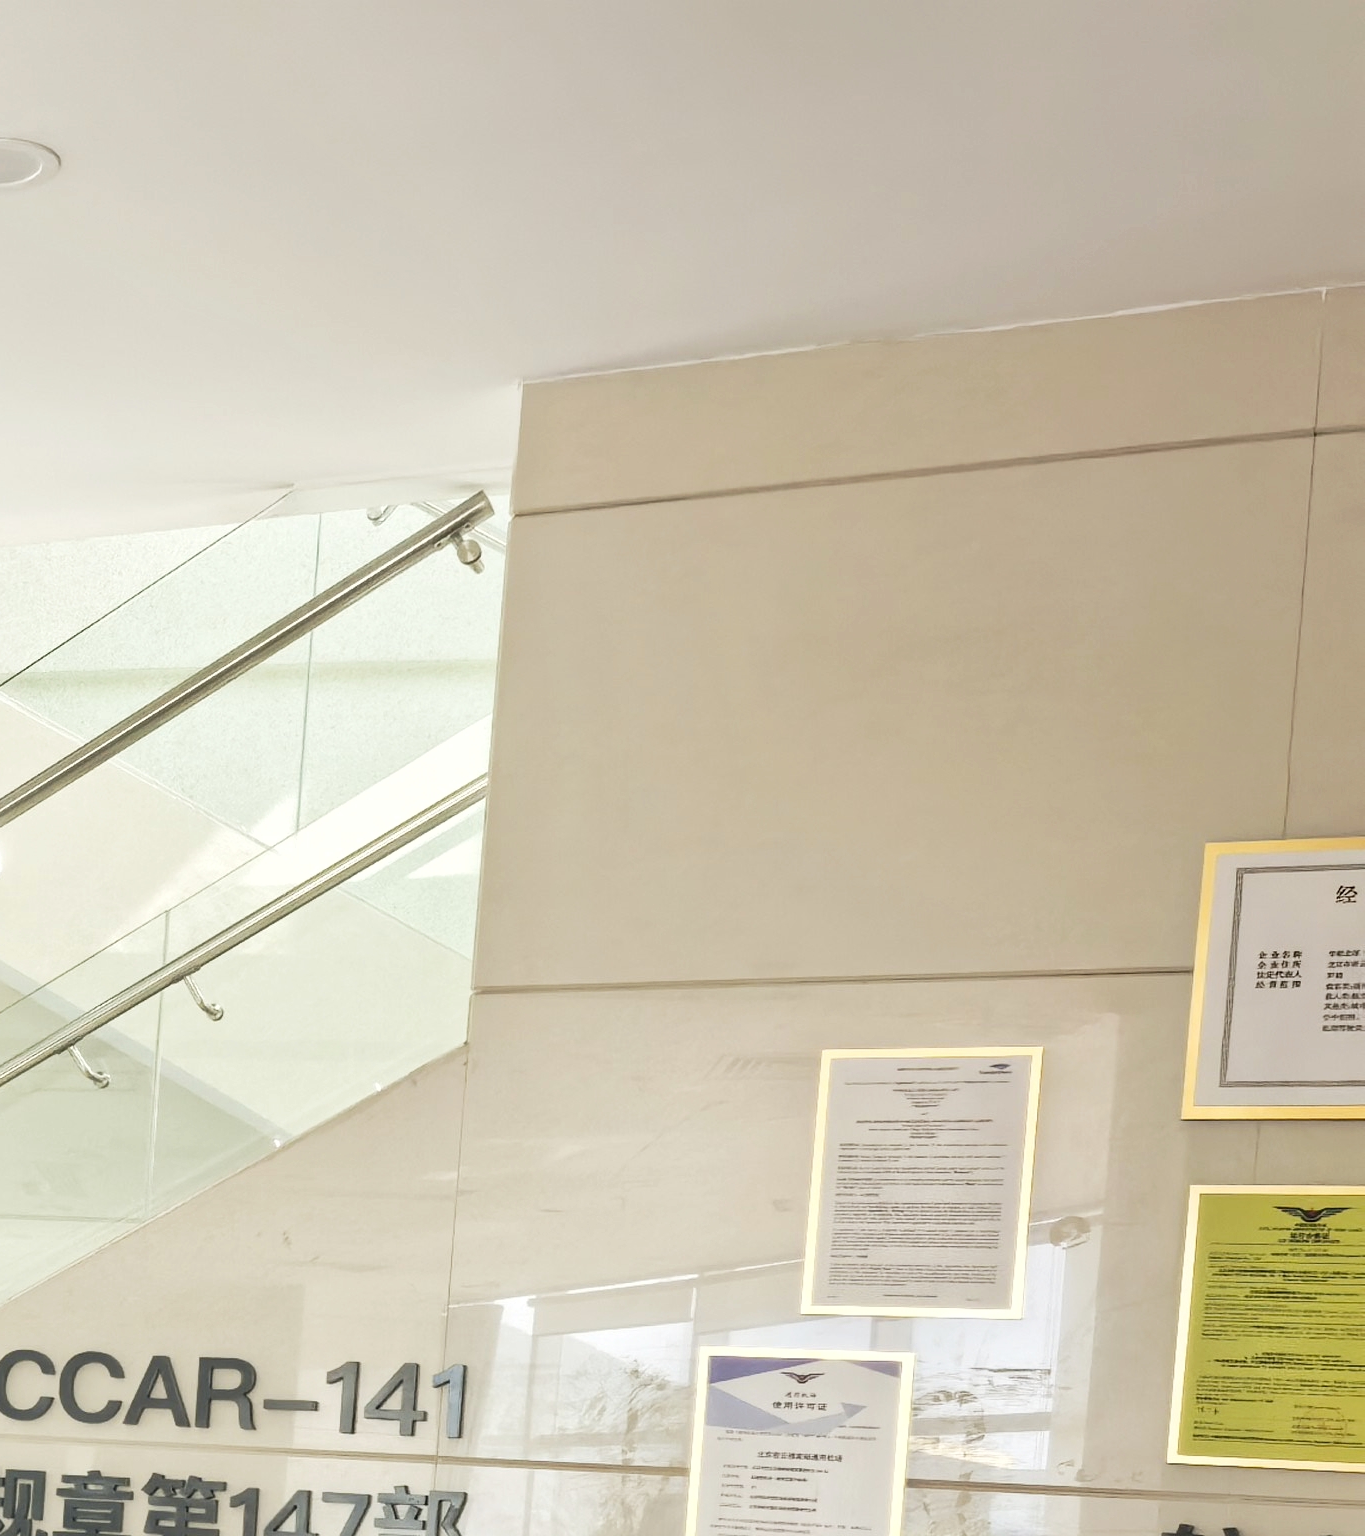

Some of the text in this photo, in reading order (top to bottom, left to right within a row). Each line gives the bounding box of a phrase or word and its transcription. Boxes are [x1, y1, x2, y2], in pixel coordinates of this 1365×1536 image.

[772, 1401, 828, 1412] 使用许可证
